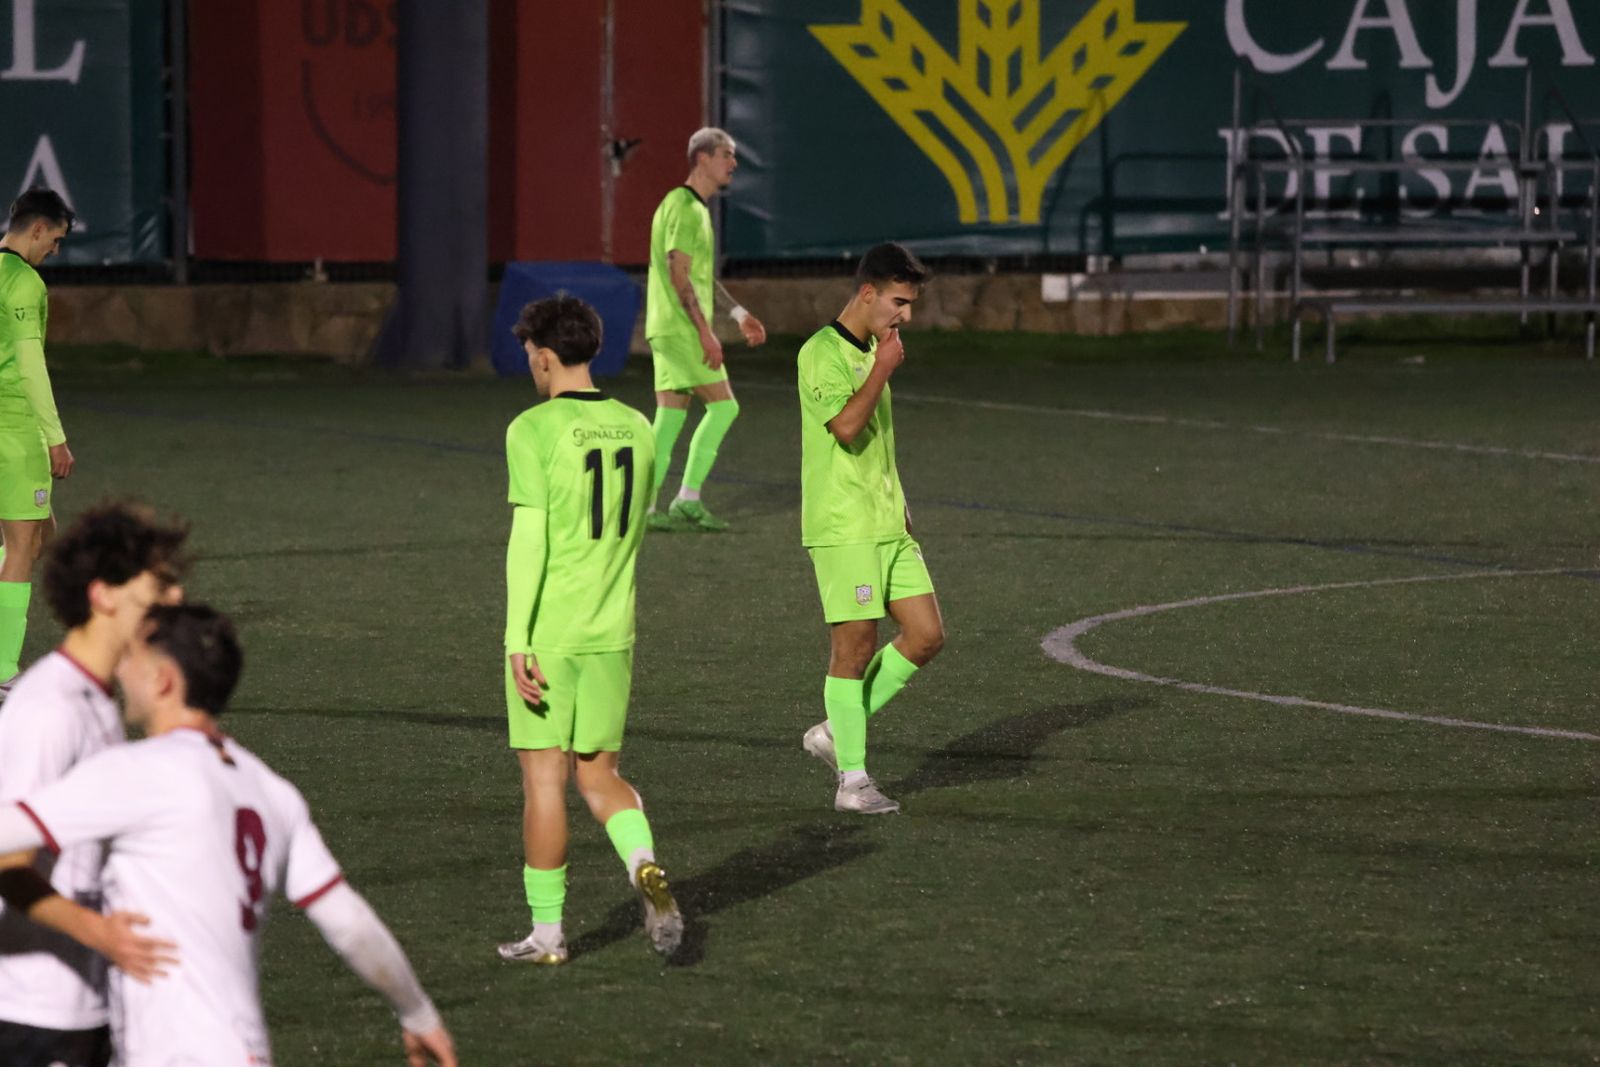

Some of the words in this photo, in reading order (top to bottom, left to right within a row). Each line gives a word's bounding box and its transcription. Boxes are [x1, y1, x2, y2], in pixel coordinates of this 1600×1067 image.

[1224, 0, 1596, 108] CAJA
[1218, 125, 1363, 220] DE
[572, 428, 635, 447] GUINALDO
[585, 446, 635, 540] 11
[235, 808, 267, 933] 9
